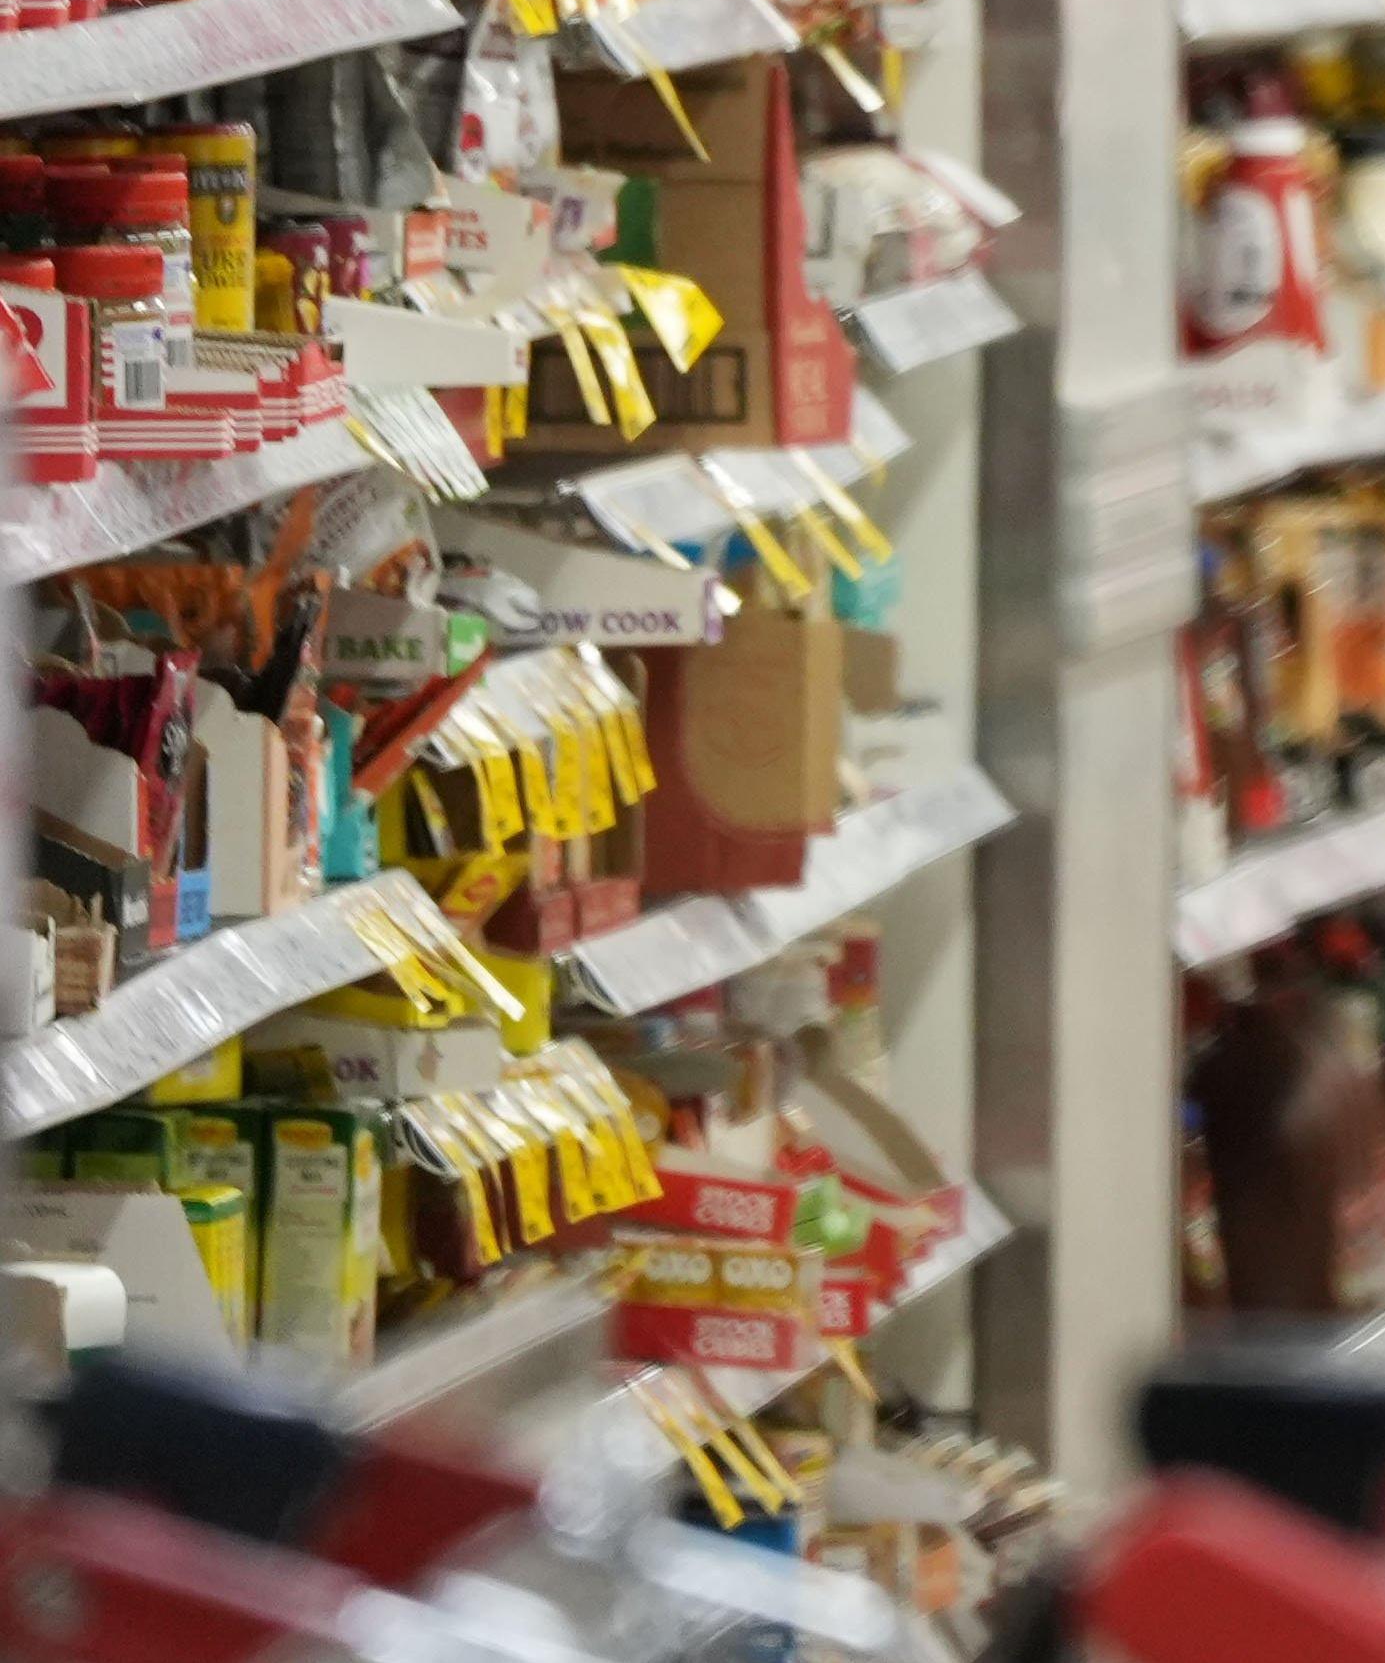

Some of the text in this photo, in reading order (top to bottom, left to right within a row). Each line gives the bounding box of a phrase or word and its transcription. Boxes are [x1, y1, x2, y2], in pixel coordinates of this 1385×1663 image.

[602, 610, 679, 635] COOK
[337, 635, 423, 661] BAKE
[720, 1254, 795, 1288] OXO
